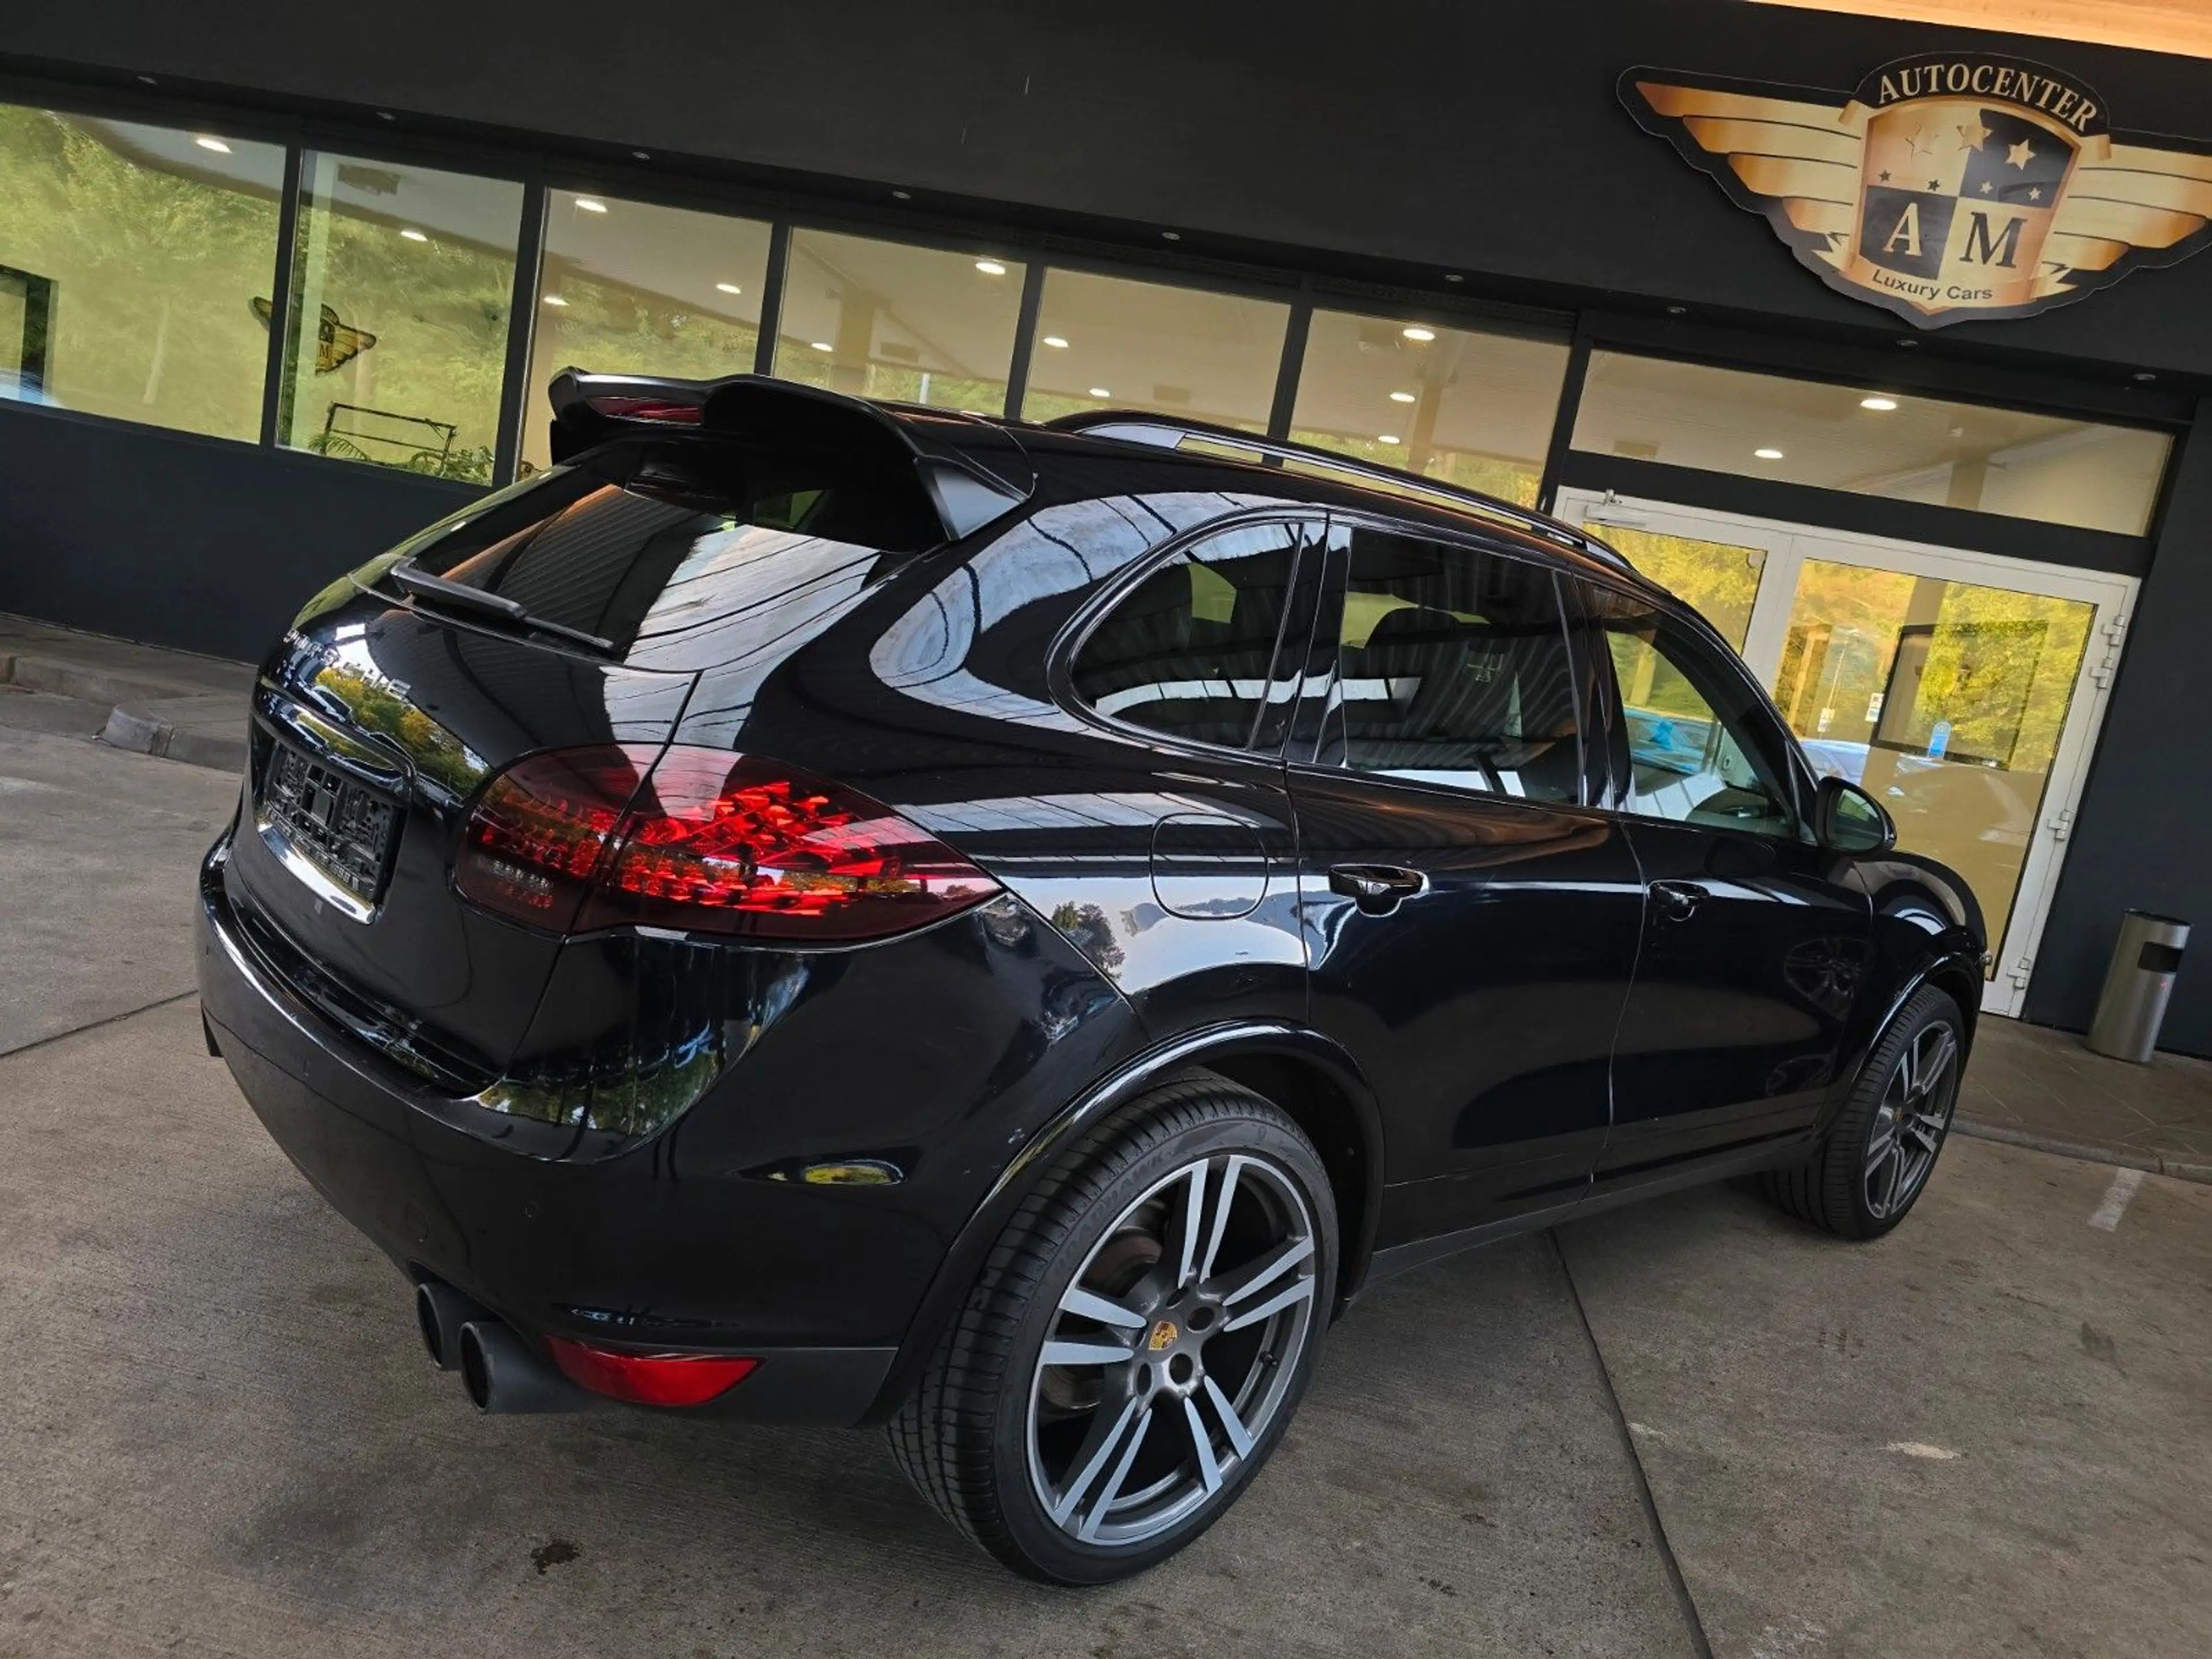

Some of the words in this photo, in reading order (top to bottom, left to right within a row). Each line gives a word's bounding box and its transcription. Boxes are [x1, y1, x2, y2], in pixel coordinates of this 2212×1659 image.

[1878, 63, 2097, 132] AUTOCENTER
[1883, 202, 1922, 256] A
[1959, 211, 2027, 268] M
[1872, 269, 1941, 300] Luxury
[1946, 286, 1993, 300] Cars
